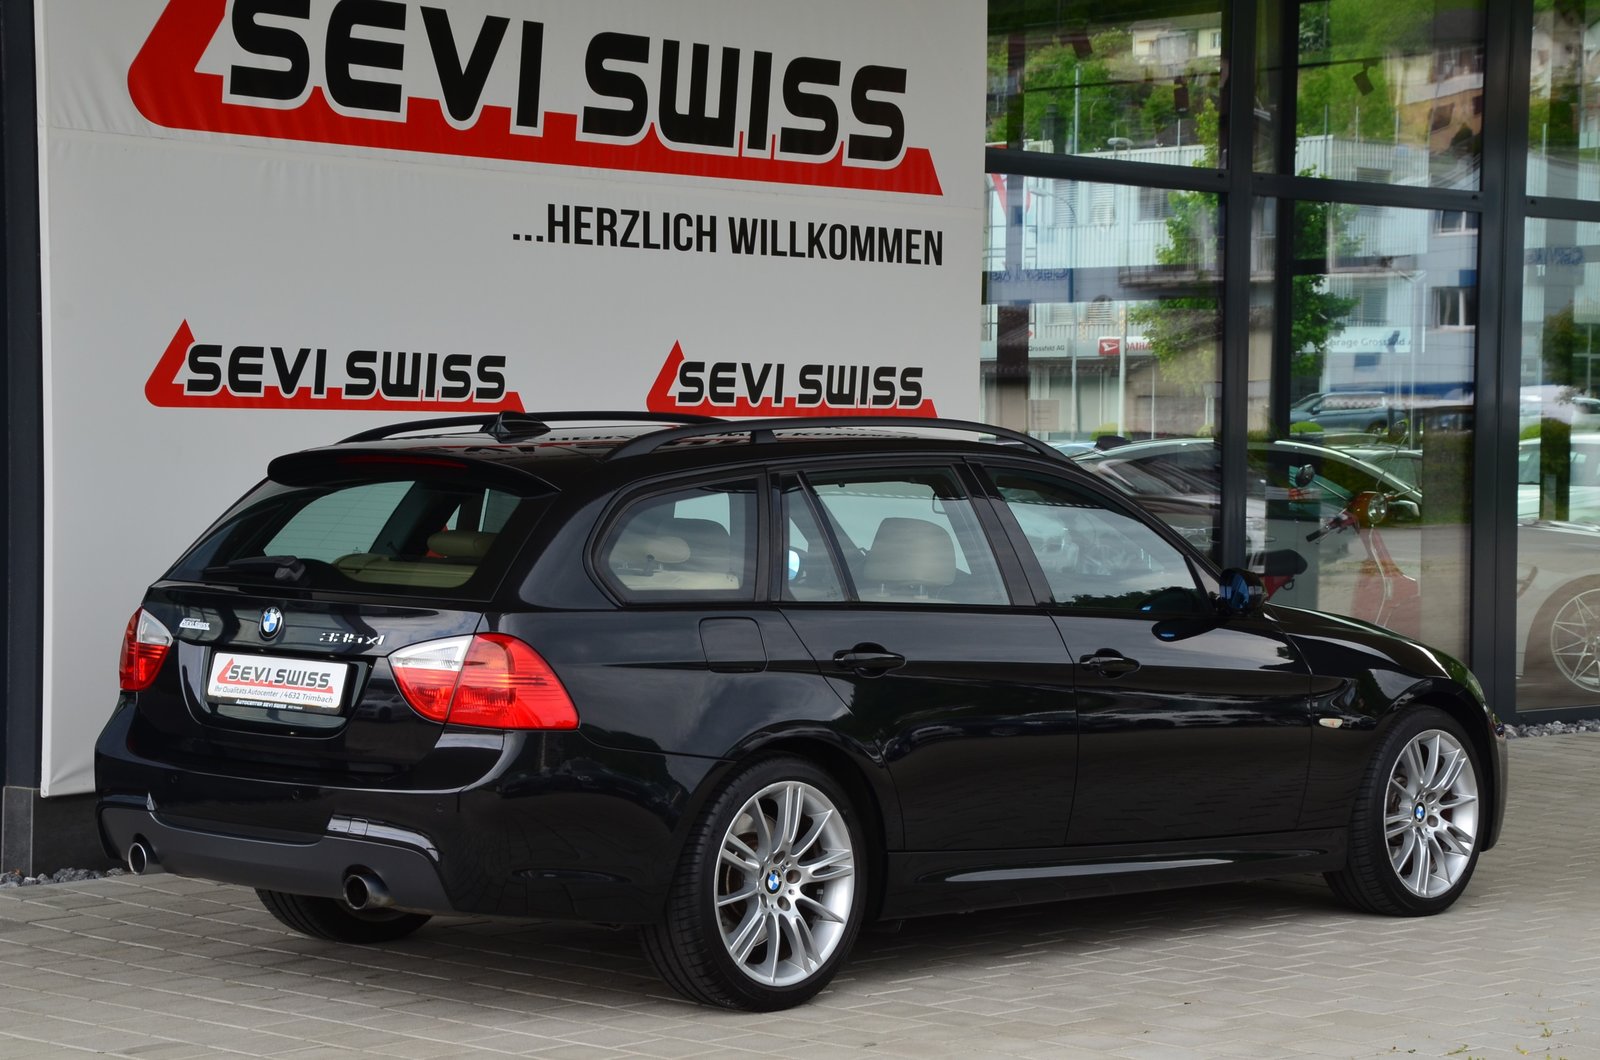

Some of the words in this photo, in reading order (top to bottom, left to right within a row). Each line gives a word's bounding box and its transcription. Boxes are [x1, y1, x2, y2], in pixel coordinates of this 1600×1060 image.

[229, 0, 544, 128] SEVI
[581, 32, 907, 162] SWISS
[512, 204, 717, 253] ...HERZLICH
[728, 217, 943, 266] WILLKOMMEN
[187, 344, 327, 397] SEVI
[345, 350, 506, 400] SWISS
[676, 361, 784, 404] SEVI
[798, 365, 923, 406] SWISS
[228, 664, 270, 682] SEVI
[274, 669, 331, 689] SWISS
[247, 688, 279, 698] Autocenter
[284, 691, 301, 700] 4632
[302, 693, 334, 704] Trimbach
